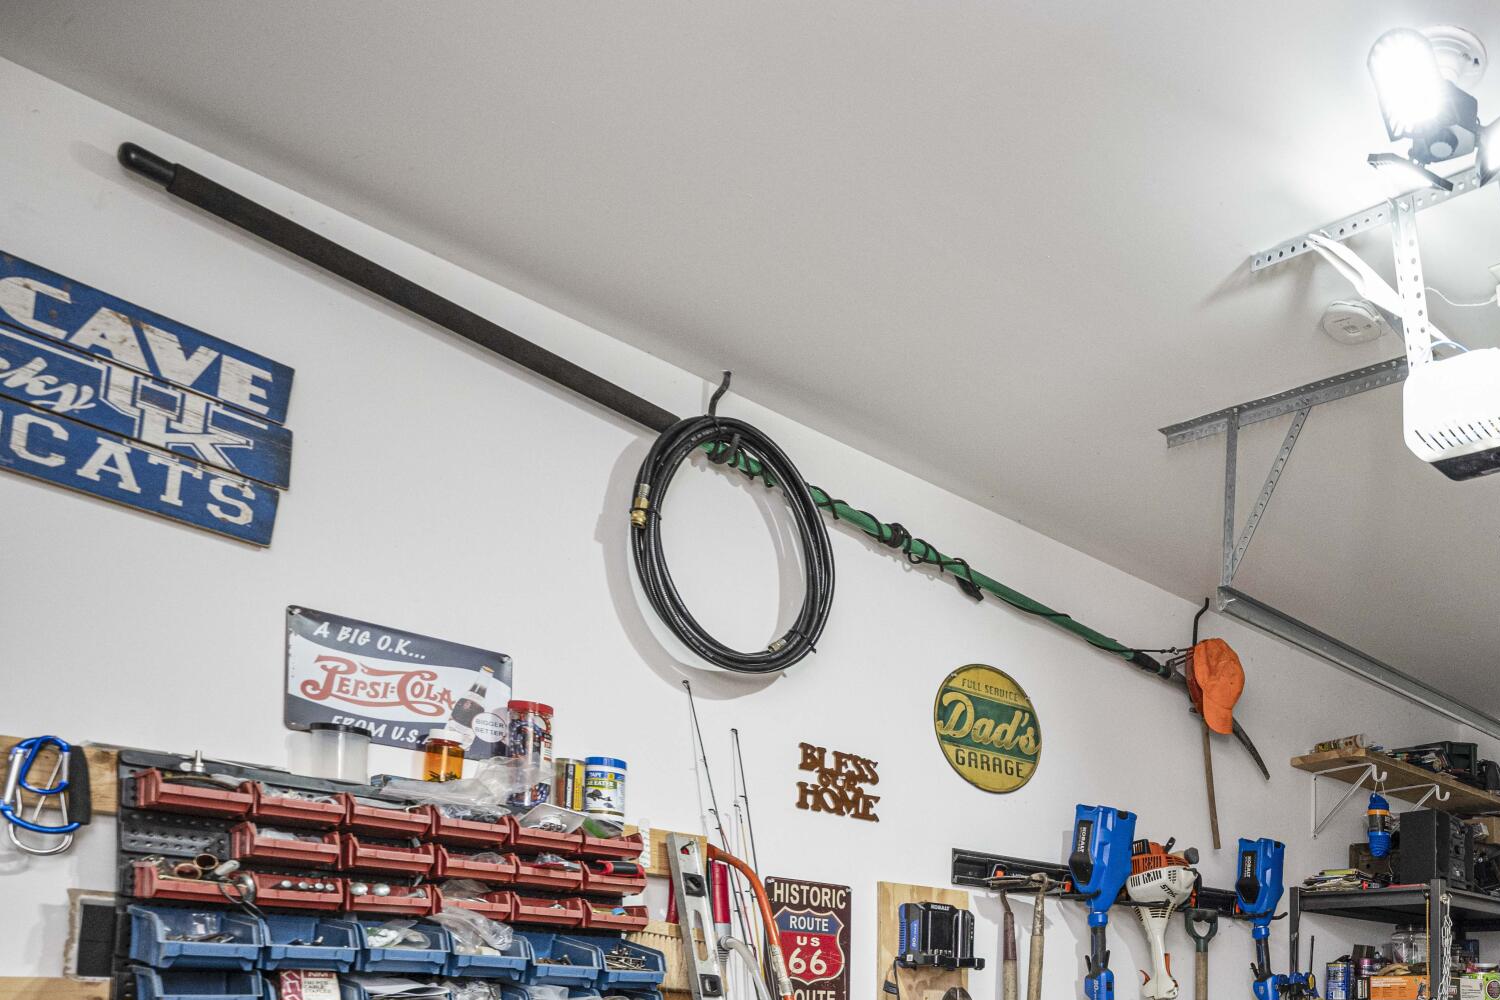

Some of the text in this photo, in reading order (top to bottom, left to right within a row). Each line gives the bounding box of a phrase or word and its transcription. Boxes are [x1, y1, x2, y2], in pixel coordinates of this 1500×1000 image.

[0, 277, 273, 415] CAVE
[0, 408, 255, 526] CATS
[313, 621, 330, 639] A
[336, 625, 371, 645] BIG
[961, 678, 1018, 703] FULL SERVICE
[936, 691, 1041, 756] Dad's
[798, 741, 880, 786] BLESS
[955, 748, 1025, 779] GARAGE
[795, 781, 881, 823] HOME
[773, 881, 847, 910] HISTORIC
[789, 915, 830, 932] ROUTE
[796, 935, 821, 947] US
[788, 947, 828, 976] 66
